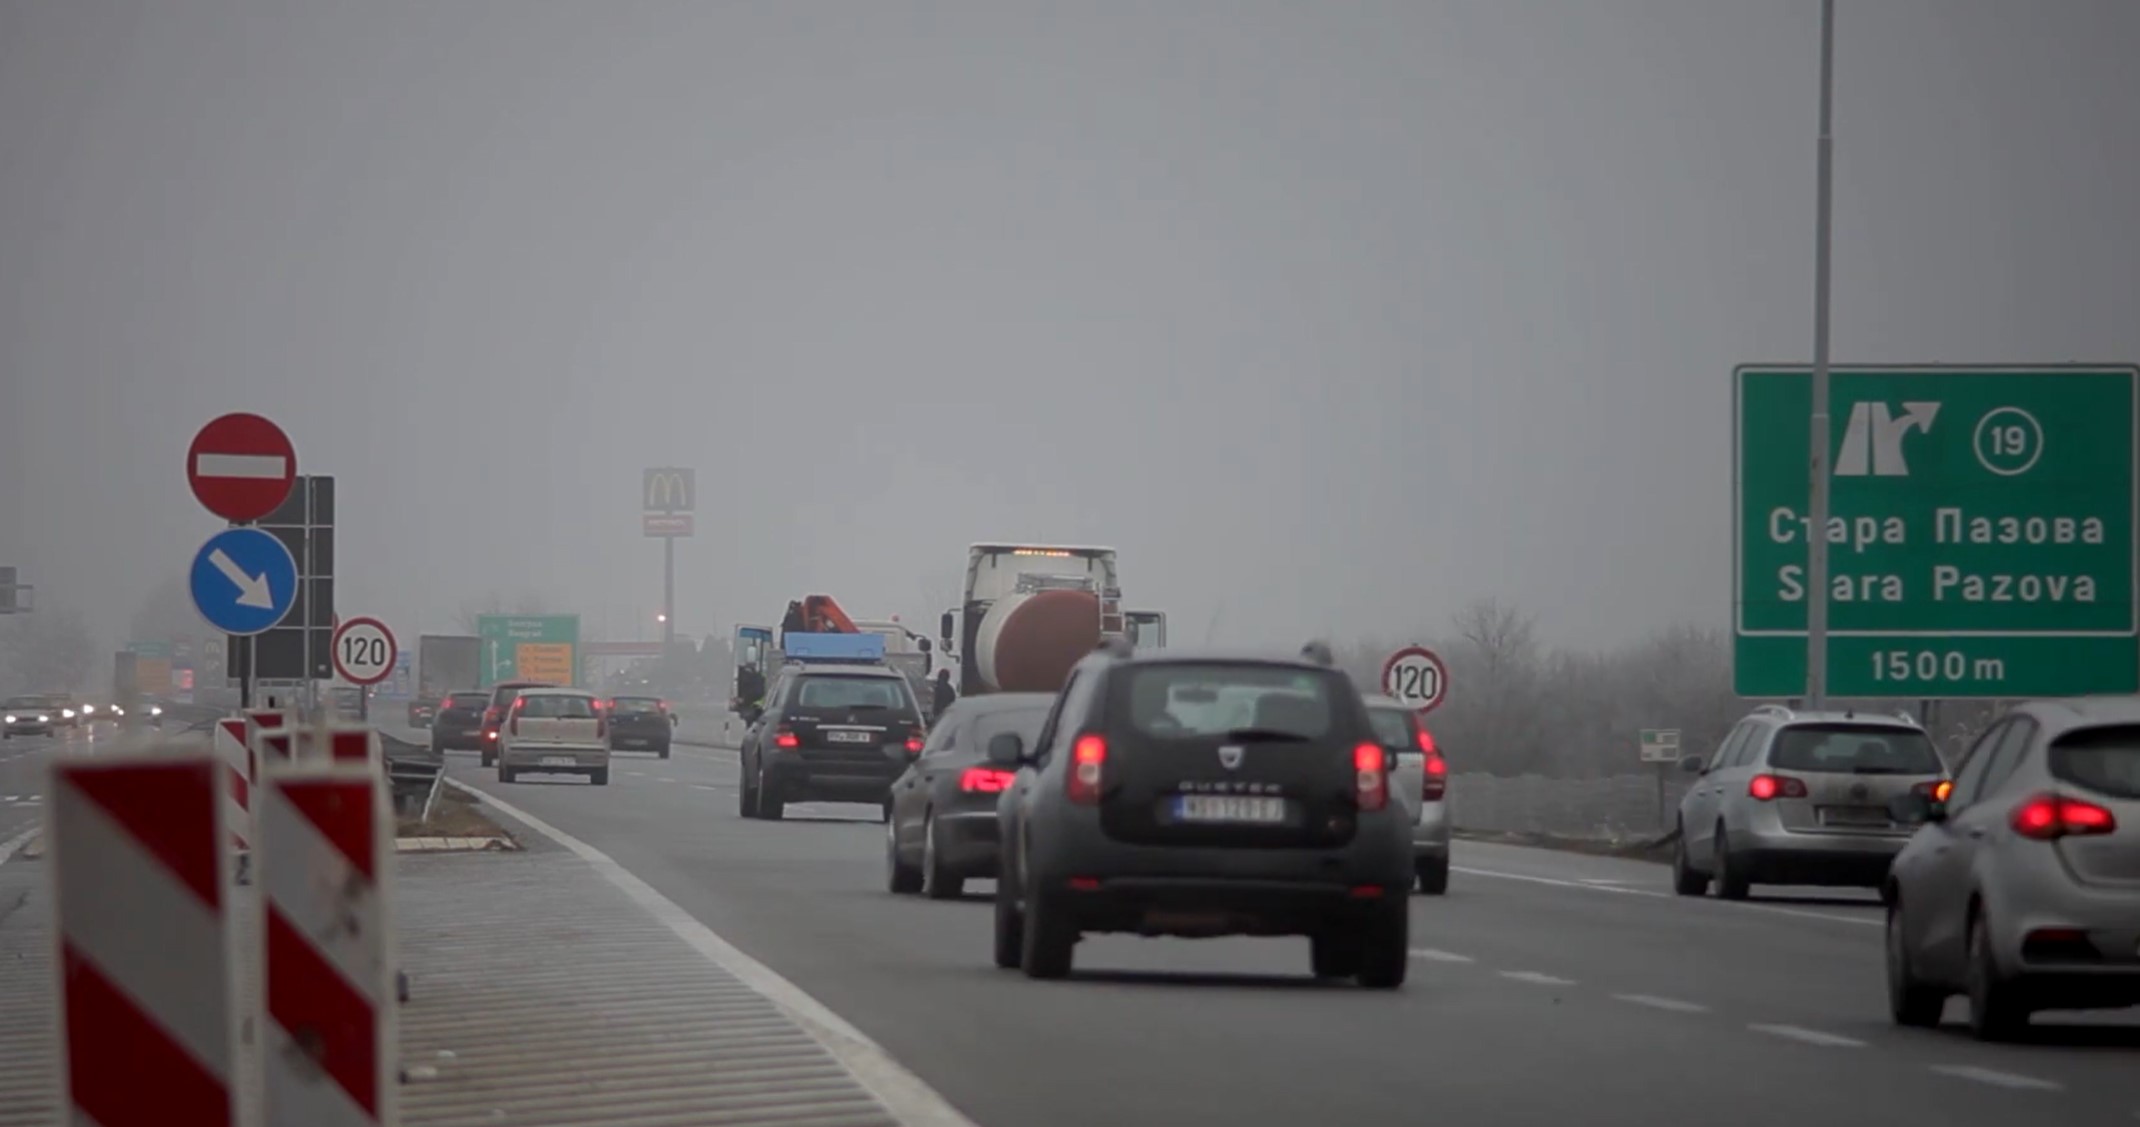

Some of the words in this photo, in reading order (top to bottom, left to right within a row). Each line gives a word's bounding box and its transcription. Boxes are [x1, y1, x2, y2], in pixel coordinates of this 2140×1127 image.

[1991, 426, 2026, 456] 19
[1935, 507, 2104, 543] Пазова
[1778, 565, 1903, 601] Sara
[1934, 565, 2096, 601] Pazova
[344, 637, 385, 666] 120
[1872, 651, 1965, 681] 1500
[1974, 657, 2005, 681] m
[1394, 665, 1437, 699] 120
